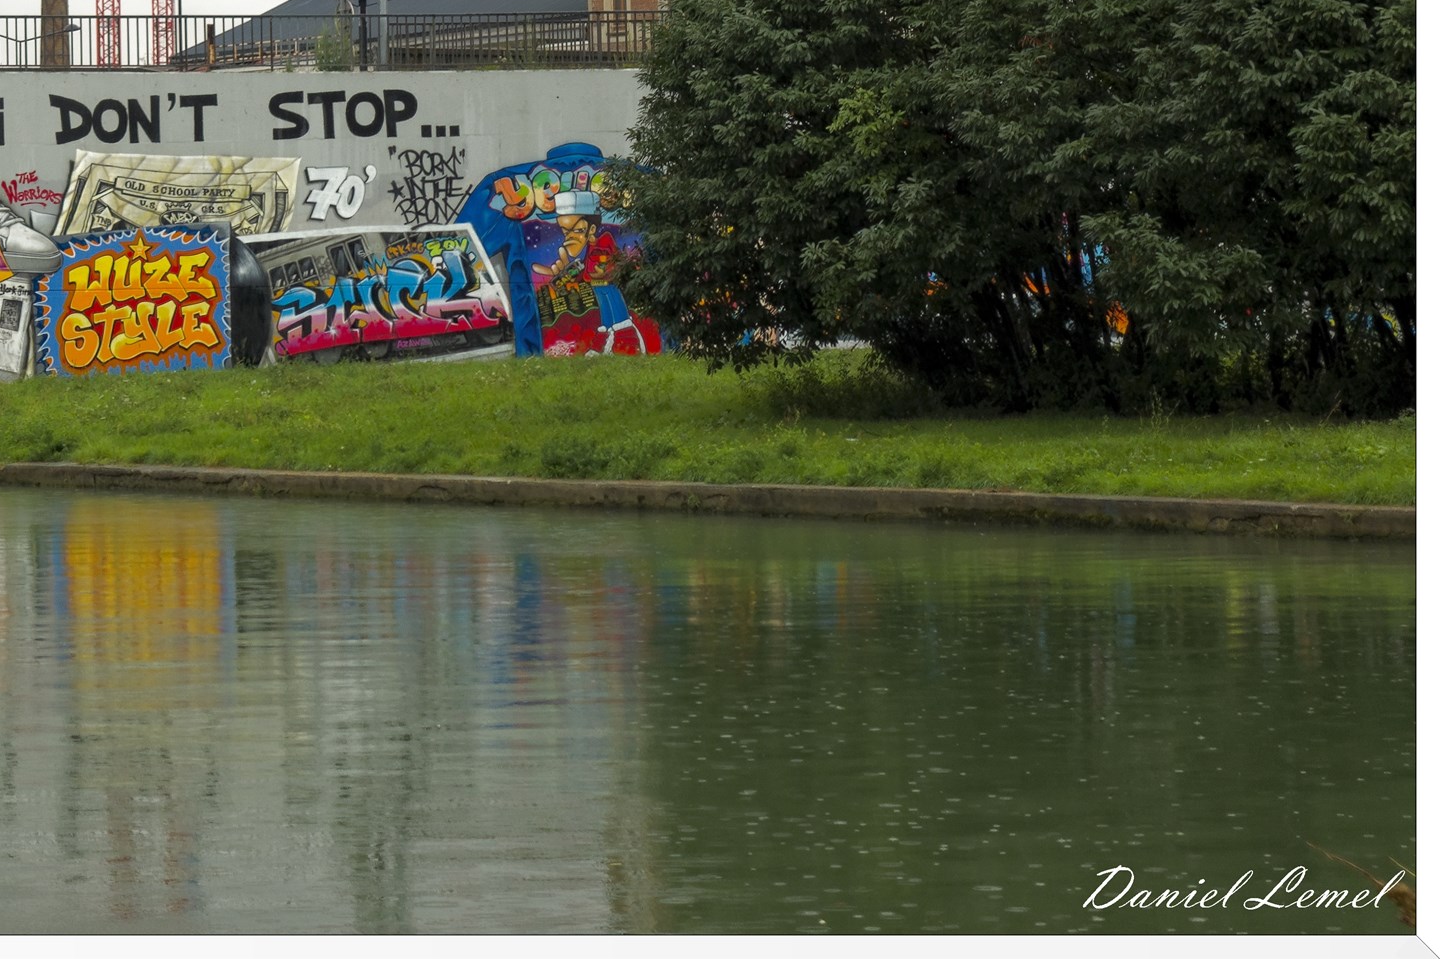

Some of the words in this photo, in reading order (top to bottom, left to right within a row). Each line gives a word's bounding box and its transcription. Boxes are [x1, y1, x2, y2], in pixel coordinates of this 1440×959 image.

[49, 92, 218, 145] DON'T
[268, 89, 460, 140] STOP...
[15, 170, 39, 185] THE
[124, 179, 146, 192] OLD
[152, 185, 198, 197] SCHOOL
[202, 187, 237, 198] PARTY
[68, 251, 217, 312] WUZE
